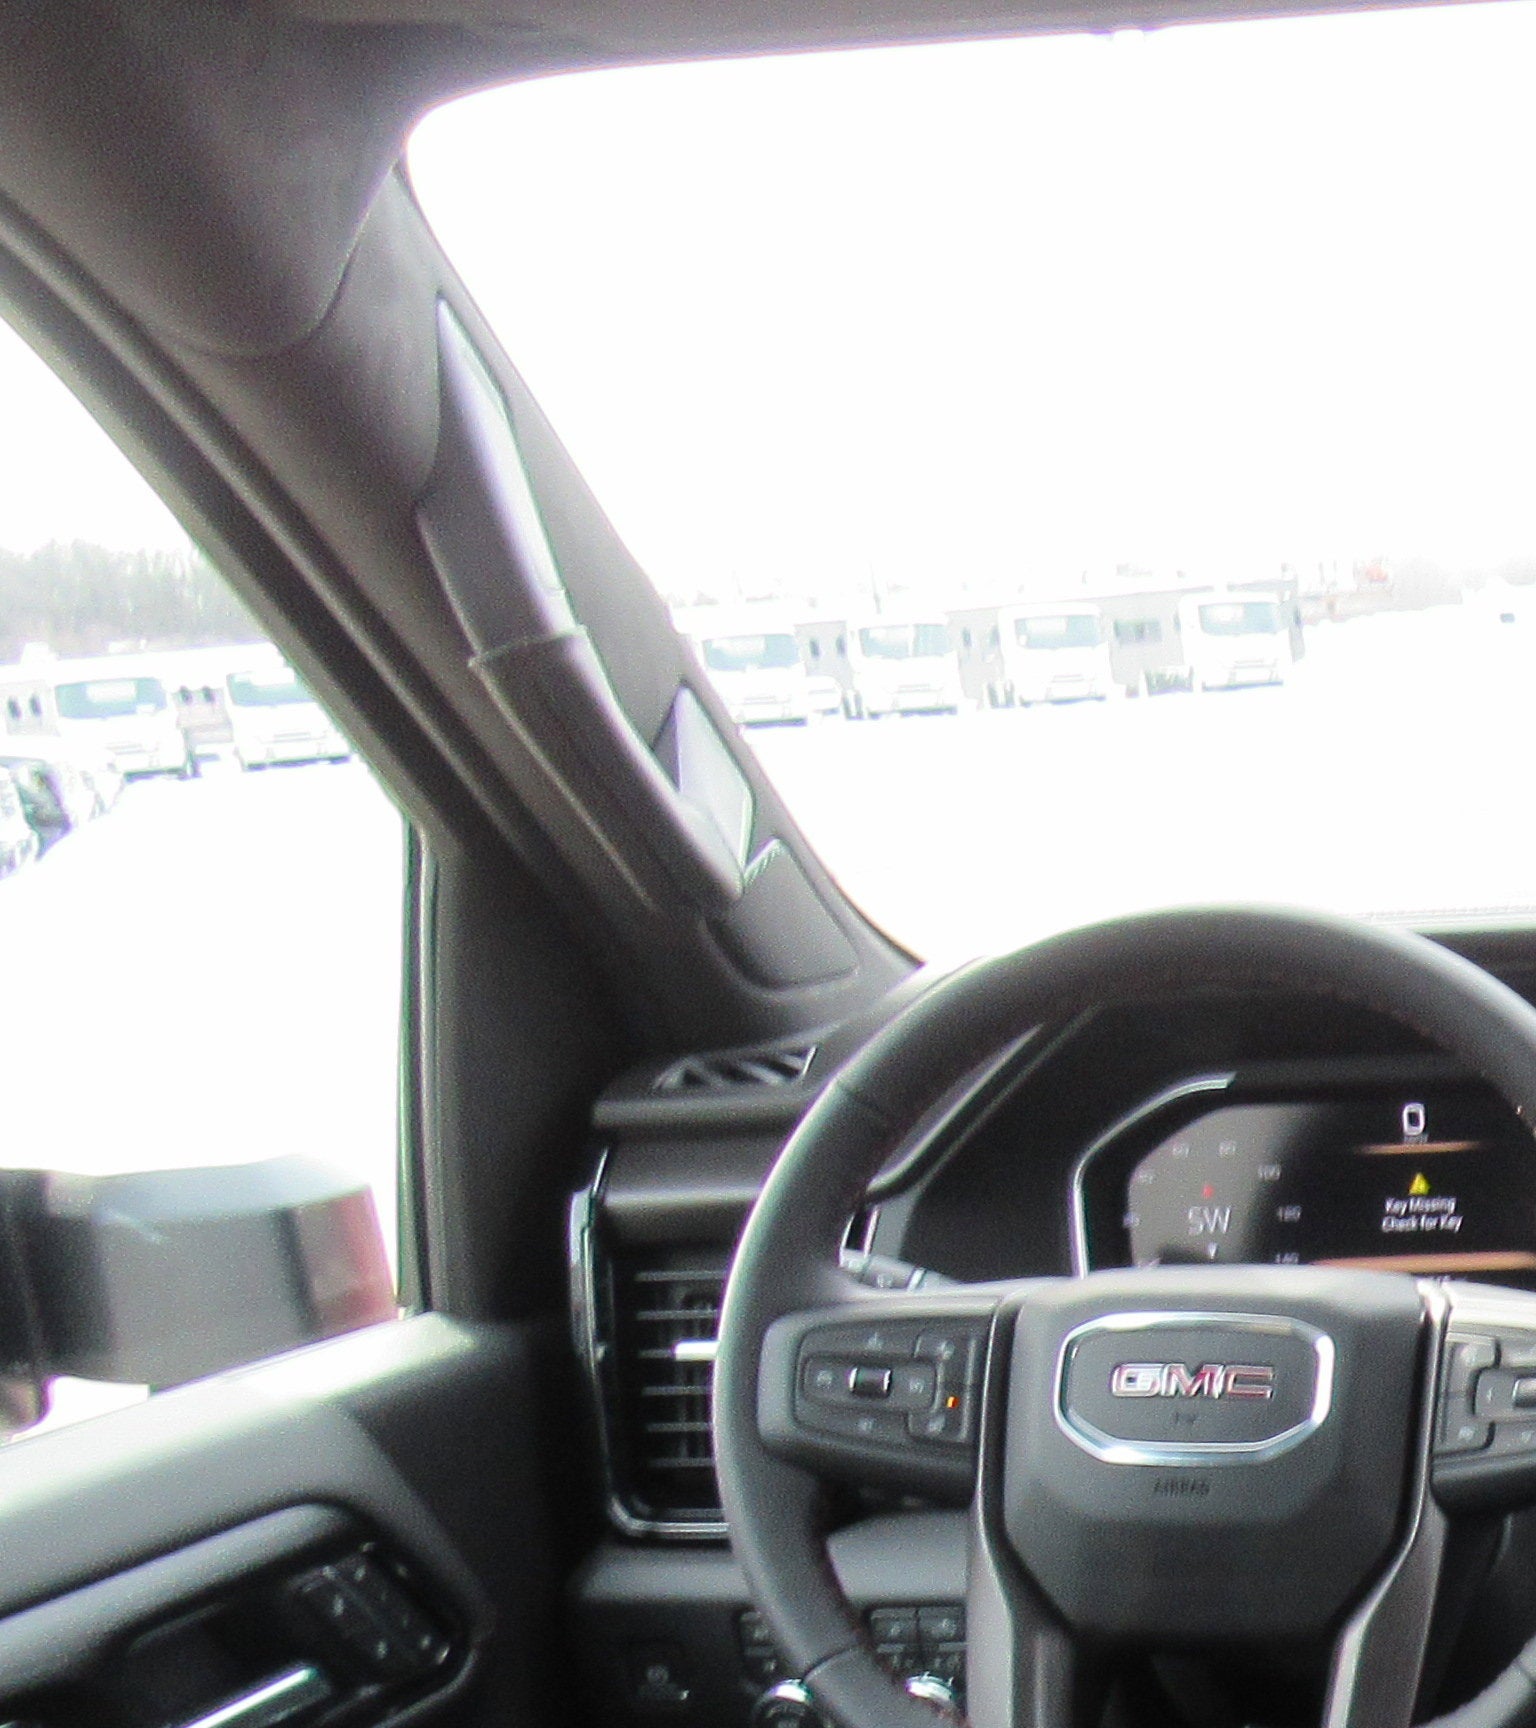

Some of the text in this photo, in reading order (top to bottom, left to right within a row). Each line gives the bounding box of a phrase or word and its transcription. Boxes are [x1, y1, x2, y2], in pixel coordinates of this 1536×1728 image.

[1402, 1101, 1426, 1136] 0
[1187, 1205, 1231, 1236] SW
[1385, 1196, 1457, 1216] Key Missing
[1440, 1213, 1463, 1233] Key
[1110, 1362, 1275, 1401] GMC
